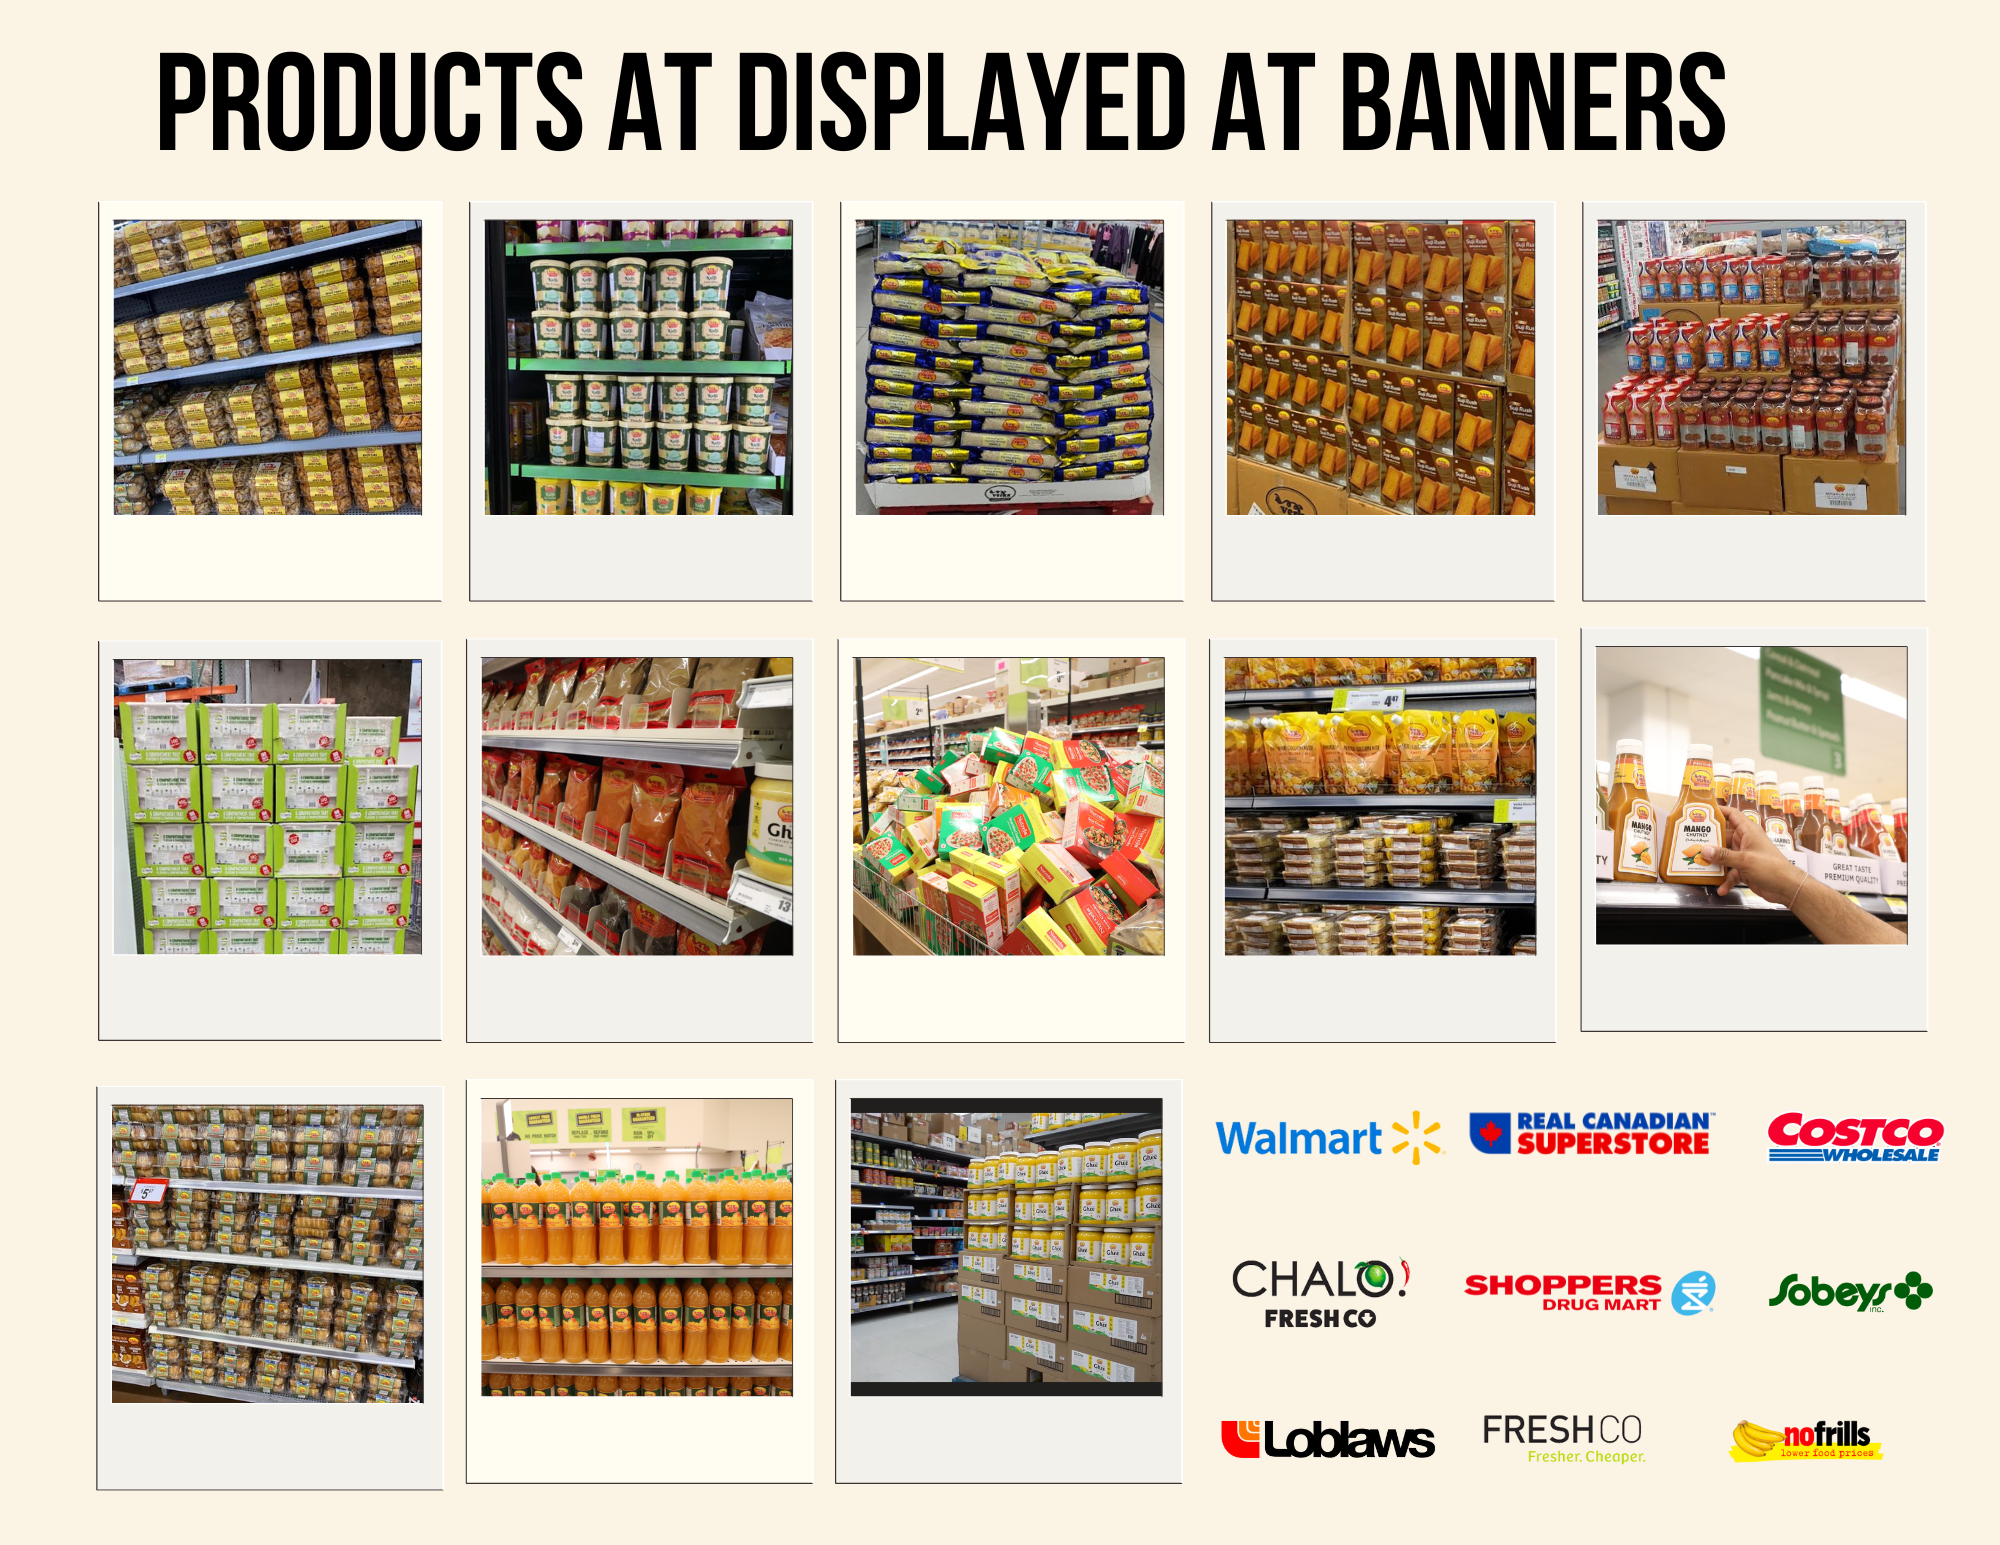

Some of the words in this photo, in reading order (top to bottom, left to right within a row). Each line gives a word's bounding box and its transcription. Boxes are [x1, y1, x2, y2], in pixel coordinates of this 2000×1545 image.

[1632, 820, 1652, 832] MANGO
[1683, 825, 1711, 833] MANGO
[1040, 865, 1053, 881] Nutrela
[1833, 863, 1853, 872] GREAT
[1854, 865, 1872, 873] TASTE
[1824, 873, 1854, 882] PREMIUM
[1855, 875, 1879, 884] QUALITY
[1087, 907, 1106, 934] Nutrela
[1049, 930, 1065, 949] Nutrela
